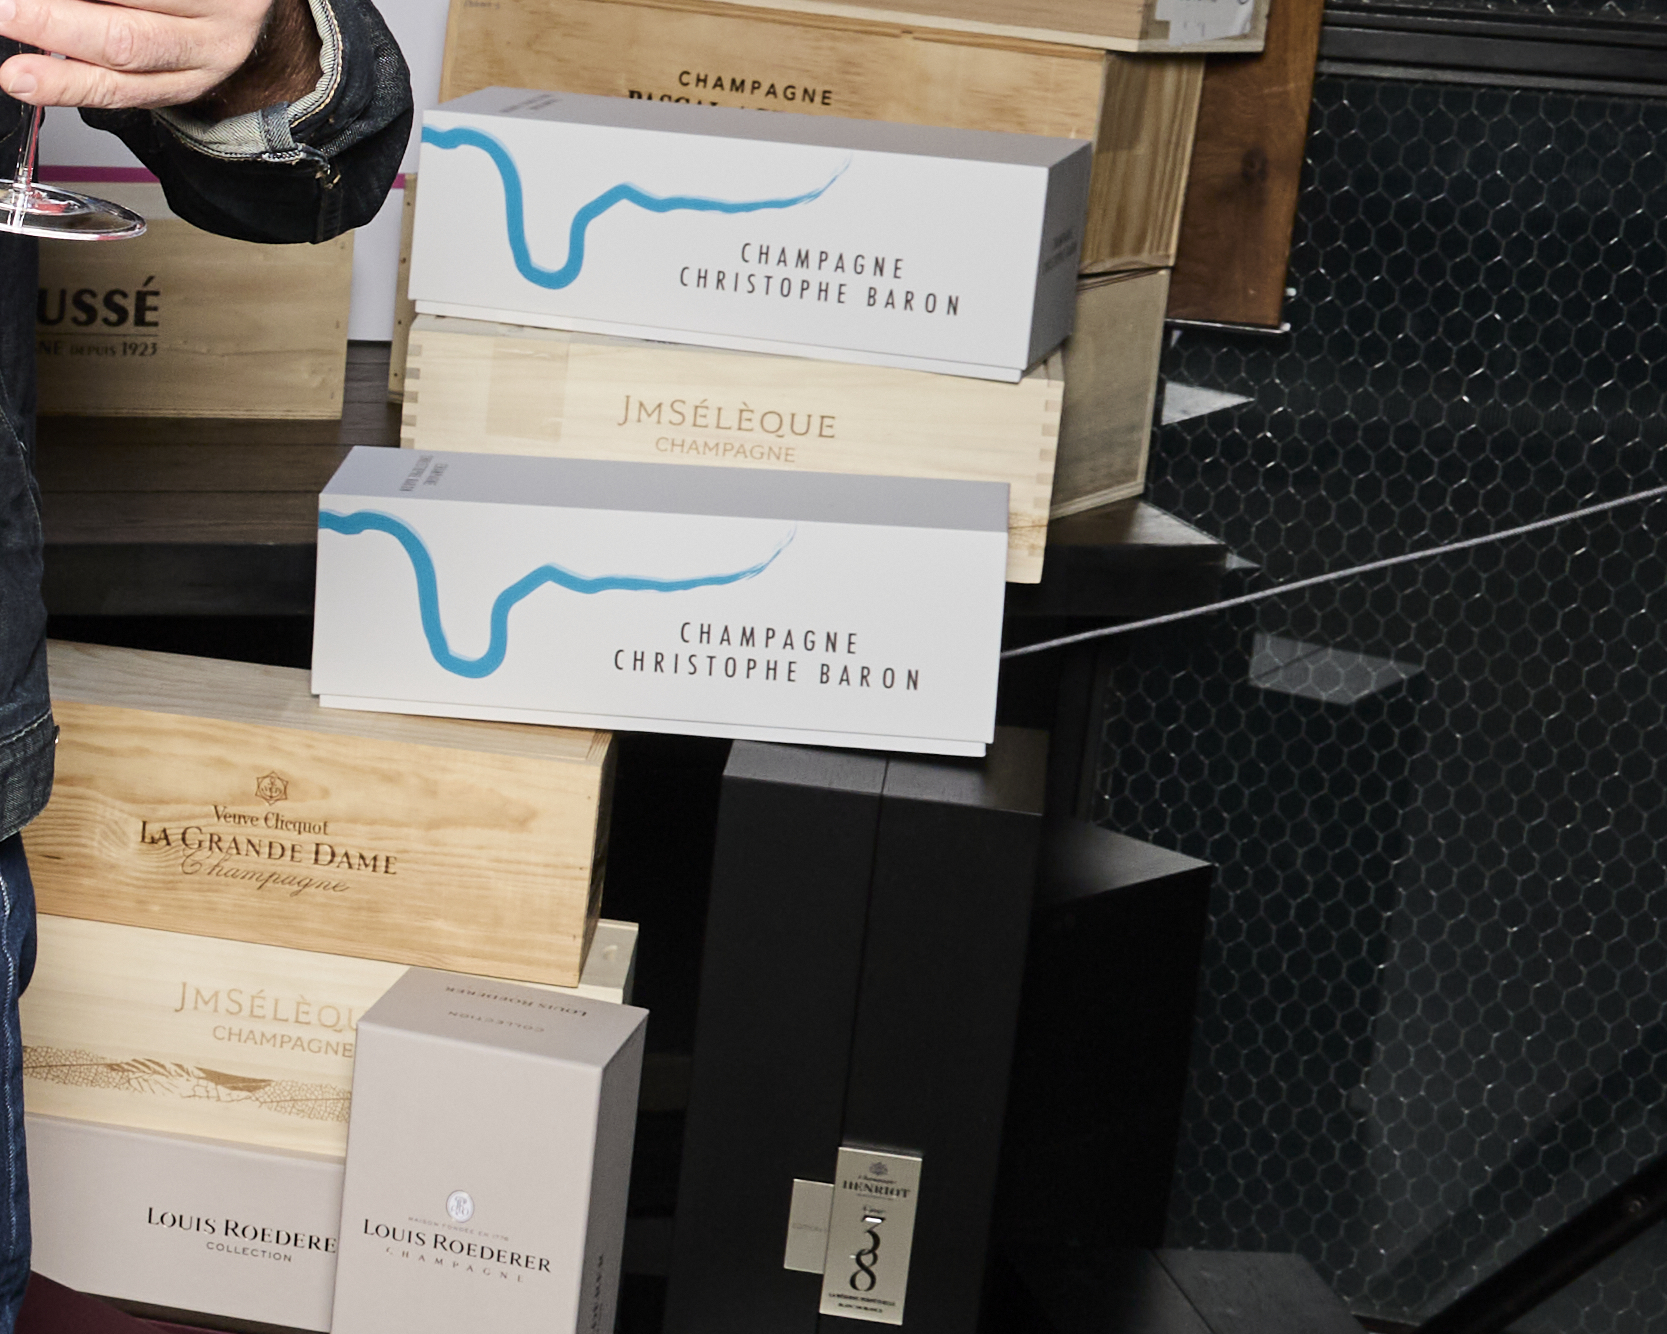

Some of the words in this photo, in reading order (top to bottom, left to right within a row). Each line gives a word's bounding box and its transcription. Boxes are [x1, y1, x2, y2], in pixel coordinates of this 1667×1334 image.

[679, 70, 833, 106] CHAMPAGNE
[741, 242, 903, 279] CHAMPAGNE
[37, 275, 161, 327] USSÉ
[680, 266, 847, 304] CHRISTOPHE
[867, 286, 959, 316] BARON
[122, 342, 158, 357] 1923
[655, 436, 796, 463] CHAMPAGNE
[680, 621, 857, 654] CHAMPAGNE
[614, 649, 797, 682] CHRISTOPHE
[820, 663, 919, 691] BARON
[212, 804, 260, 827] Veuve
[263, 811, 329, 836] Clicquot
[140, 820, 172, 847] LA
[181, 825, 304, 863] GRANDE
[312, 842, 398, 875] DAME
[180, 848, 352, 898] Champagne
[213, 1025, 354, 1059] CHAMPAGNE
[843, 1180, 911, 1198] HENRIOT
[148, 1207, 217, 1235] LOUIS
[224, 1219, 338, 1254] ROEDERE
[363, 1218, 426, 1247] LOUIS
[432, 1233, 552, 1273] ROEDERER
[206, 1241, 293, 1263] COLLECTION
[386, 1246, 524, 1284] CHAMPAGNE
